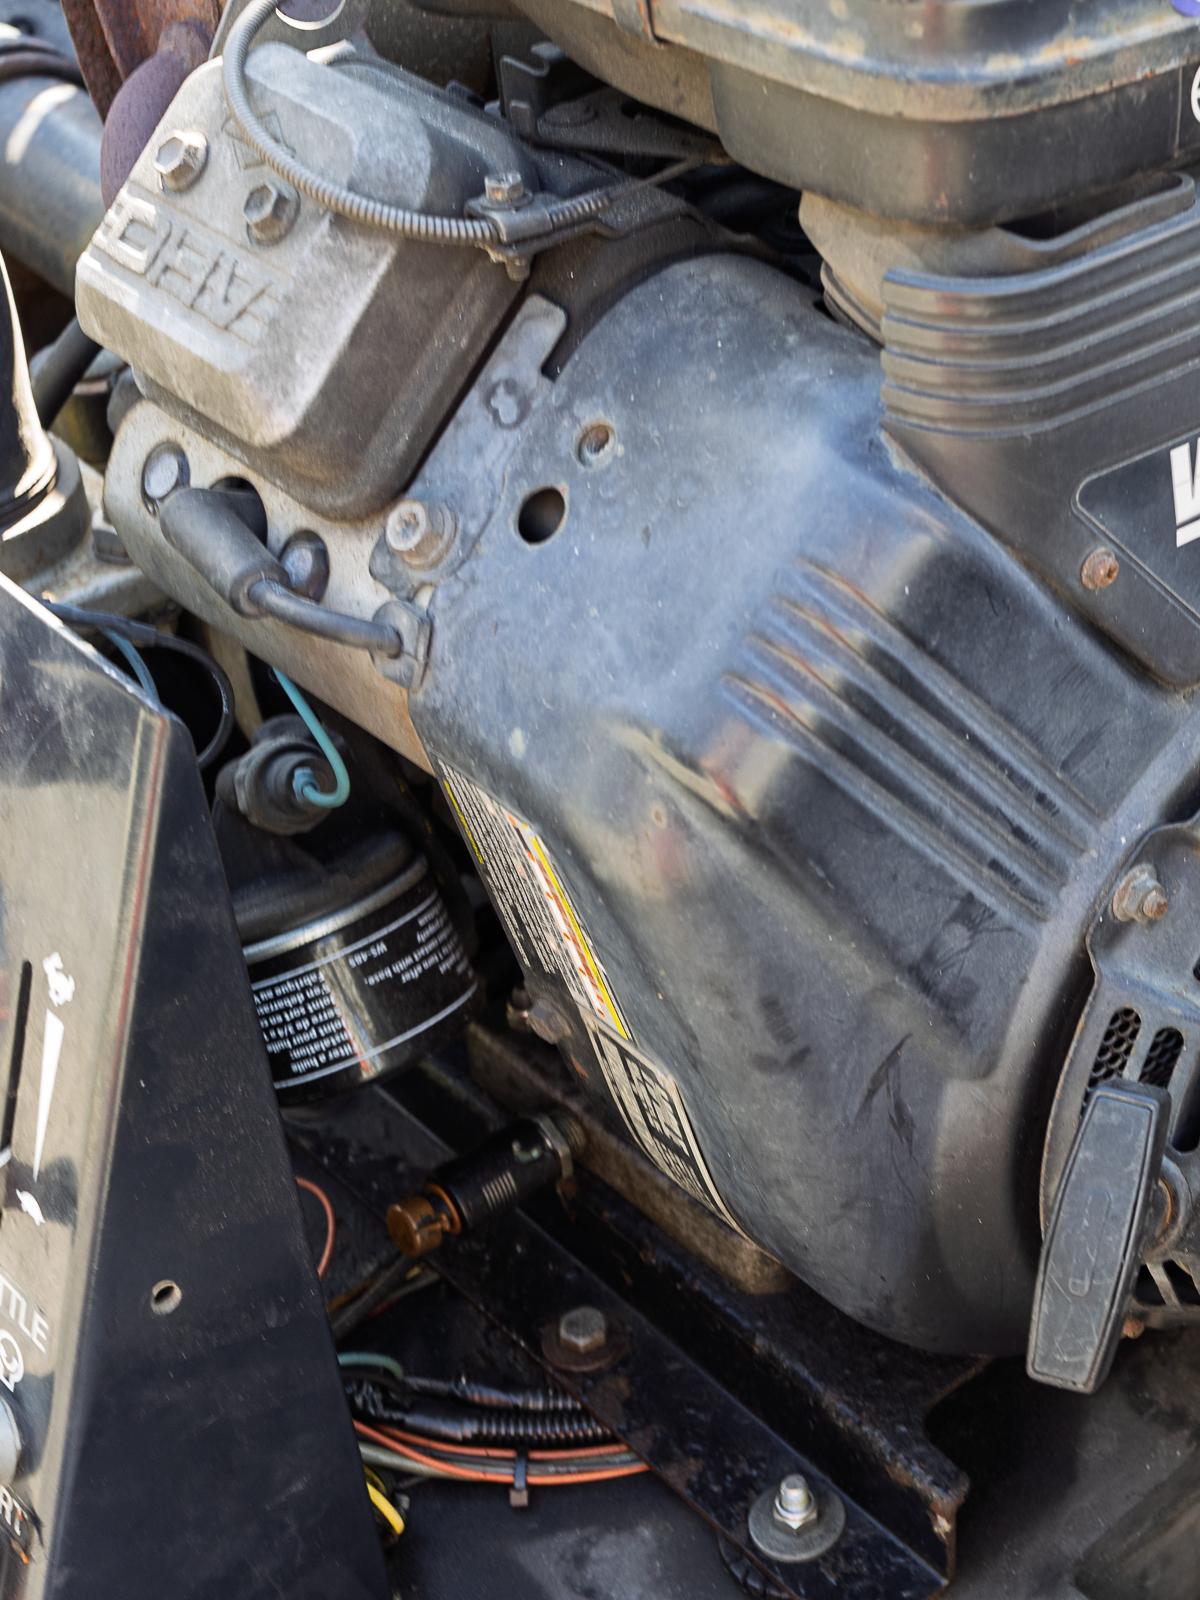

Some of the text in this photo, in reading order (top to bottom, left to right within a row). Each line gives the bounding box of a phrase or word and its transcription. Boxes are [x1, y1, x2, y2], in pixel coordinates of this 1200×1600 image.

[97, 190, 276, 331] OHV
[392, 955, 414, 974] with
[401, 963, 423, 984] after
[276, 1023, 295, 1038] 3/4
[295, 1018, 310, 1031] de
[292, 1026, 317, 1046] pour
[328, 1042, 357, 1060] ilter
[290, 1056, 319, 1074] huile
